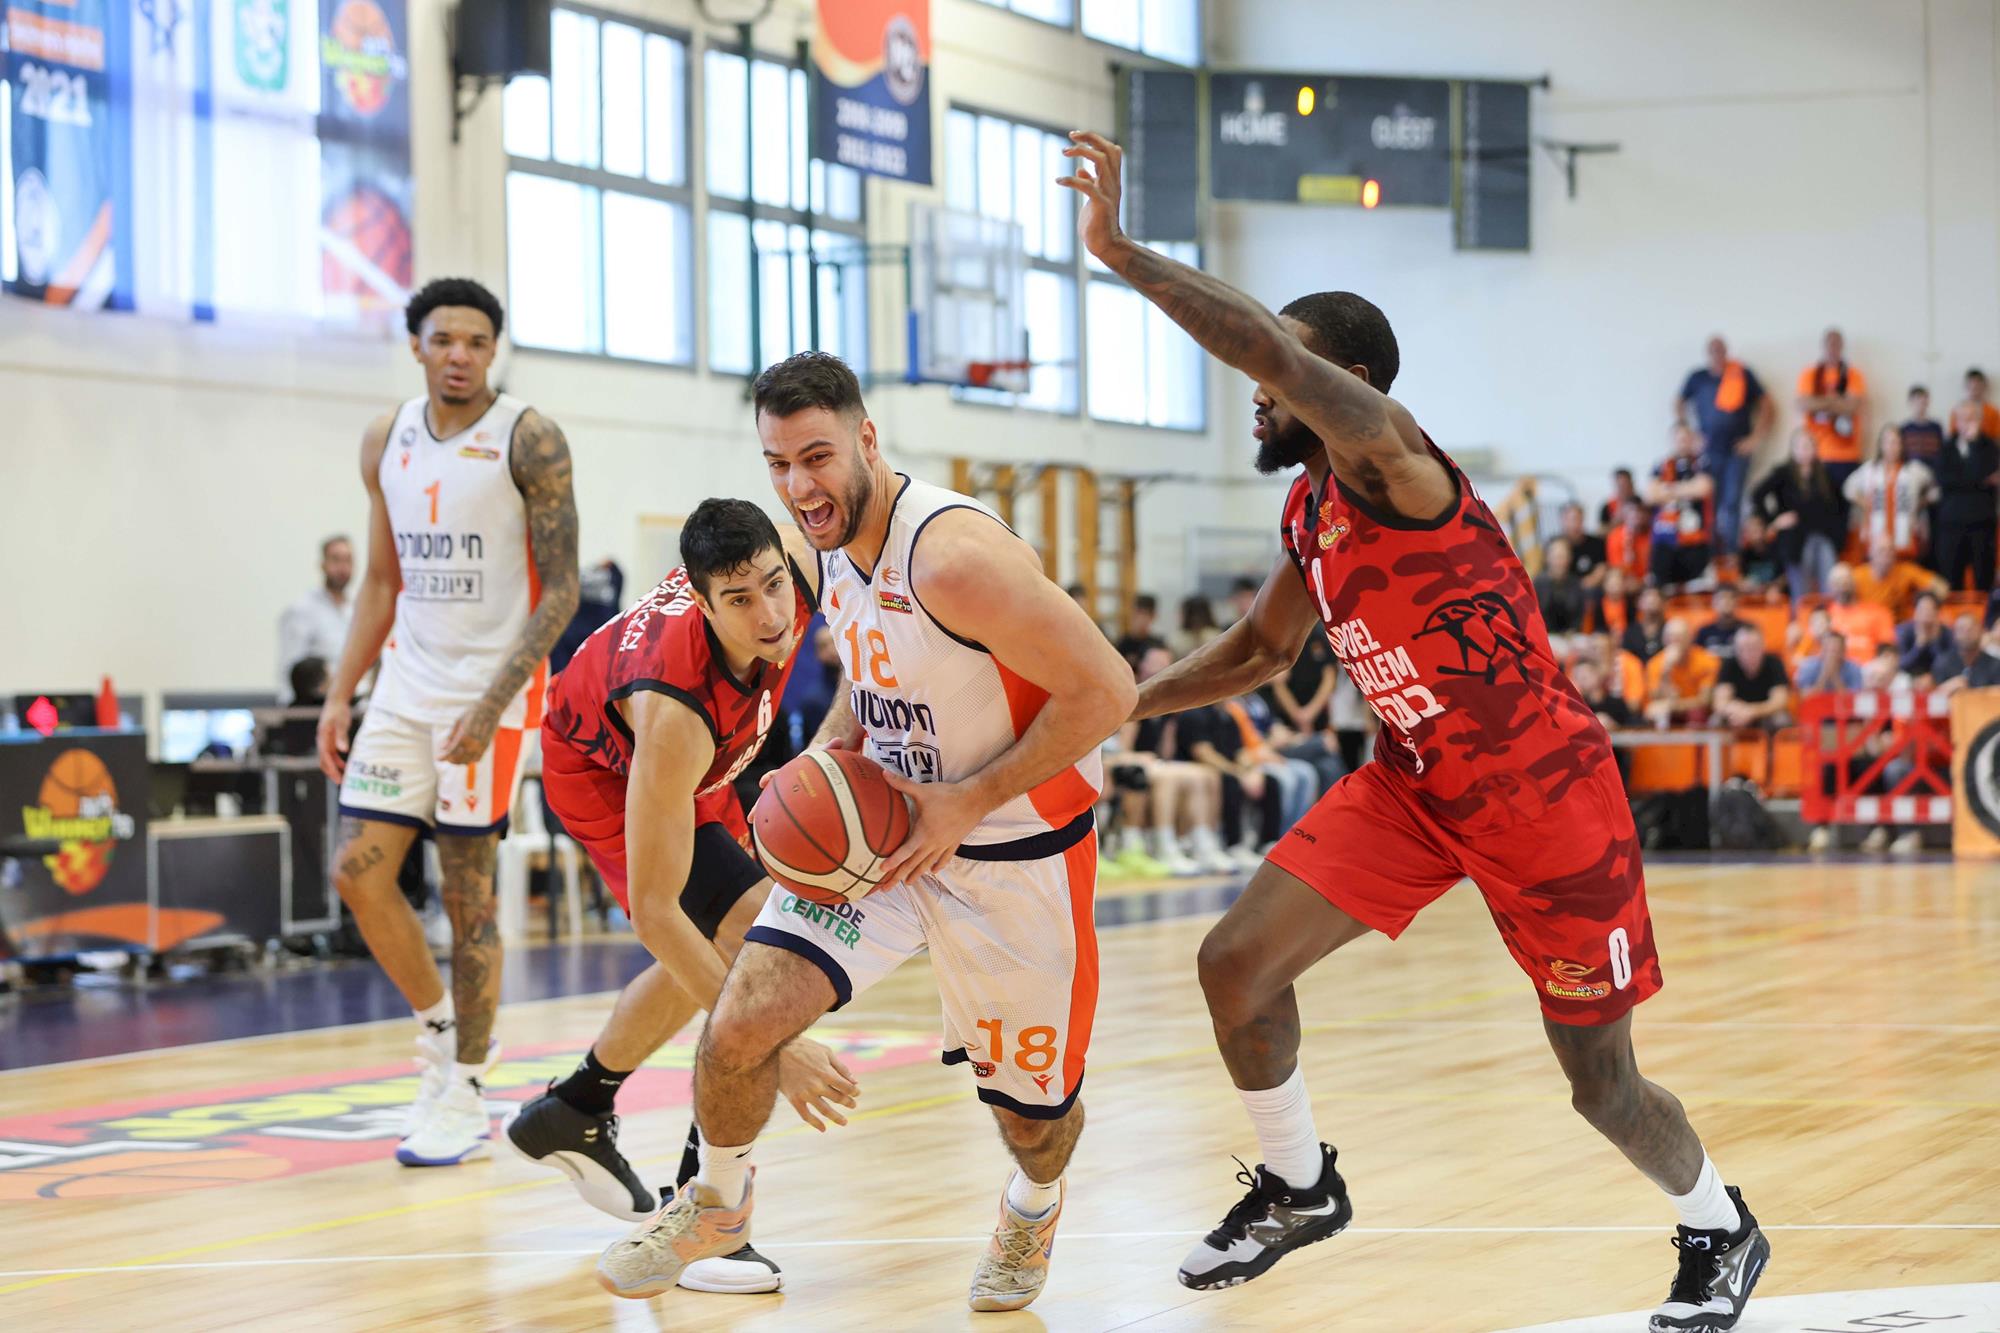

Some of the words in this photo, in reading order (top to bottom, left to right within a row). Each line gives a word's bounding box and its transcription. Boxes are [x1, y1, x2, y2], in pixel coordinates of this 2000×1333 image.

[1221, 111, 1288, 146] HOME
[1371, 115, 1435, 150] GUEST
[424, 480, 441, 525] 1
[844, 621, 899, 688] 18
[1326, 618, 1381, 659] POEL
[1343, 645, 1420, 696] SALEM
[757, 689, 772, 736] 6
[781, 895, 862, 951] CENTER
[1608, 927, 1632, 990] 0
[976, 1018, 1058, 1073] 18
